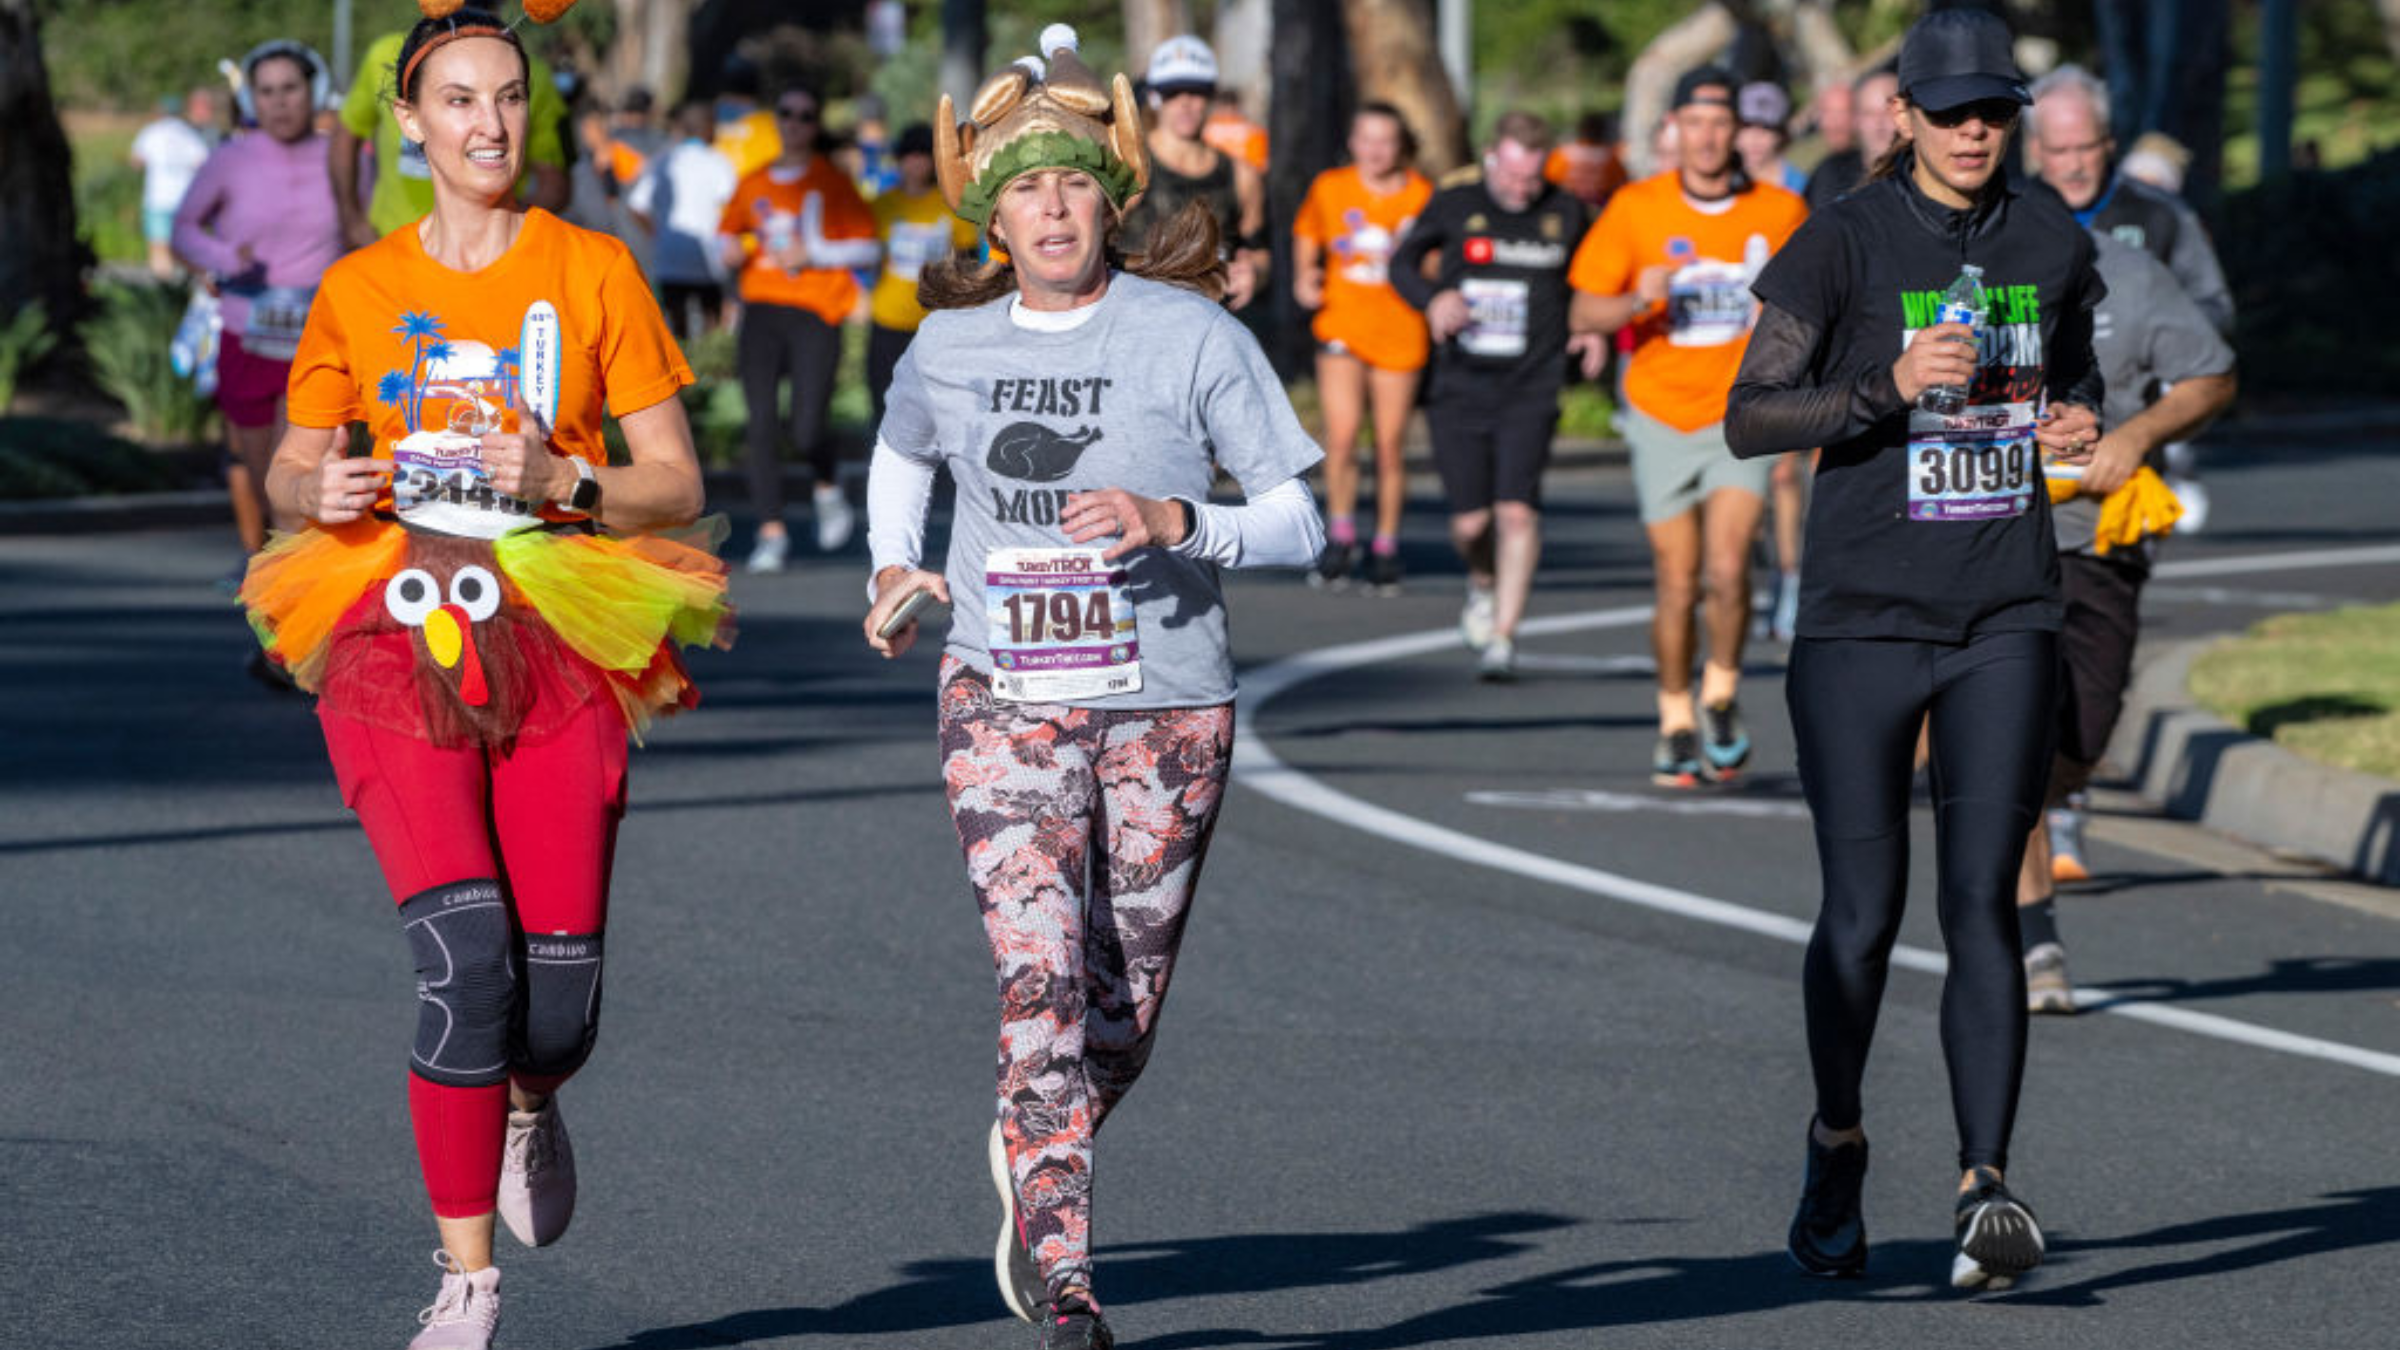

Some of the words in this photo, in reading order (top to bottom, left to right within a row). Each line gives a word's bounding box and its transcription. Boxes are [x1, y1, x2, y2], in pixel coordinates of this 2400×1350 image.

[1901, 287, 2009, 328] WON
[2005, 284, 2041, 323] LIFE
[535, 326, 547, 397] TURKEY
[990, 377, 1113, 418] FEAST
[1919, 443, 2024, 495] 3099
[990, 487, 1094, 527] MO
[1002, 591, 1115, 644] 1794
[1108, 677, 1129, 690] 1794
[528, 943, 587, 957] cambivo
